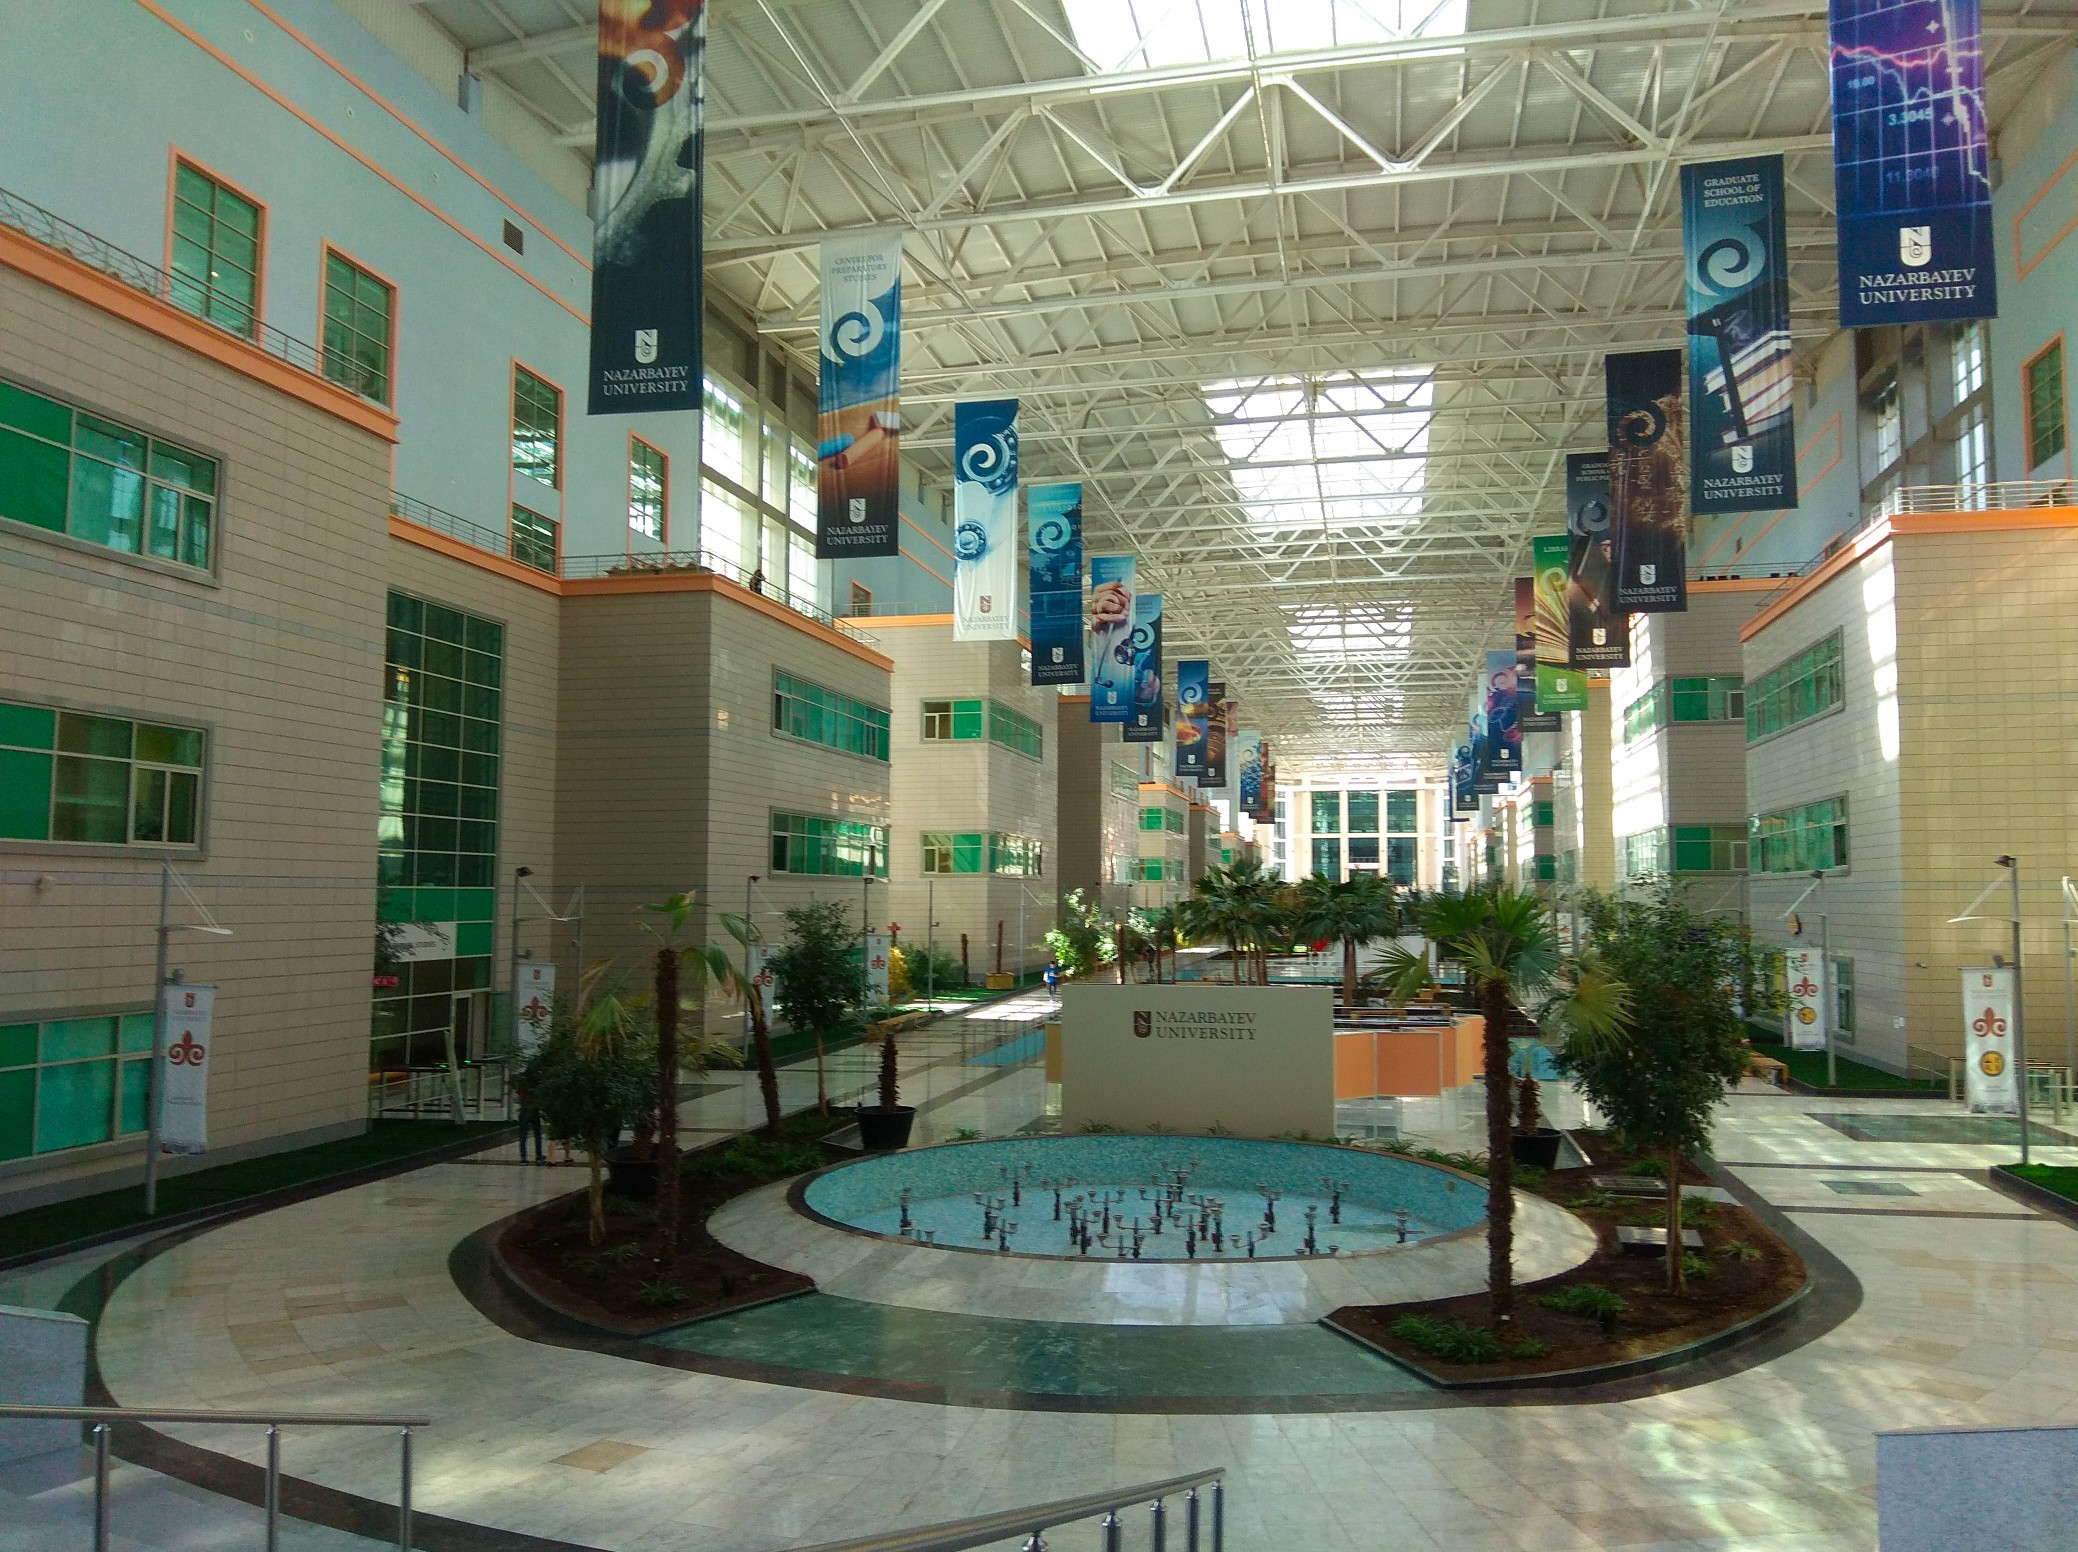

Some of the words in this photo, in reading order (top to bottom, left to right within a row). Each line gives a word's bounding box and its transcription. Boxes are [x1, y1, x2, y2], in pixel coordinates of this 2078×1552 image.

[1704, 174, 1760, 187] GRADUATE
[1704, 186, 1745, 197] SCHOOL
[1746, 184, 1761, 193] OF
[1704, 194, 1764, 208] EDUCATION
[1859, 268, 1976, 288] NAZARBAYEV
[1859, 285, 1976, 305] UNIVERSITY
[603, 366, 689, 381] NAZARBAYEV
[603, 380, 689, 396] UNIVERSITY
[1703, 474, 1783, 488] NAZARBAYEV
[1703, 486, 1784, 500] UNIVERSITY
[826, 525, 889, 535] NAZARBAYEV
[826, 535, 889, 545] UNIVERSITY
[1619, 586, 1678, 595] NAZARBAYEV
[1619, 594, 1678, 603] UNIVERSITY
[1156, 1011, 1257, 1024] NAZARBAYEV
[1156, 1026, 1257, 1040] UNIVERSITY
